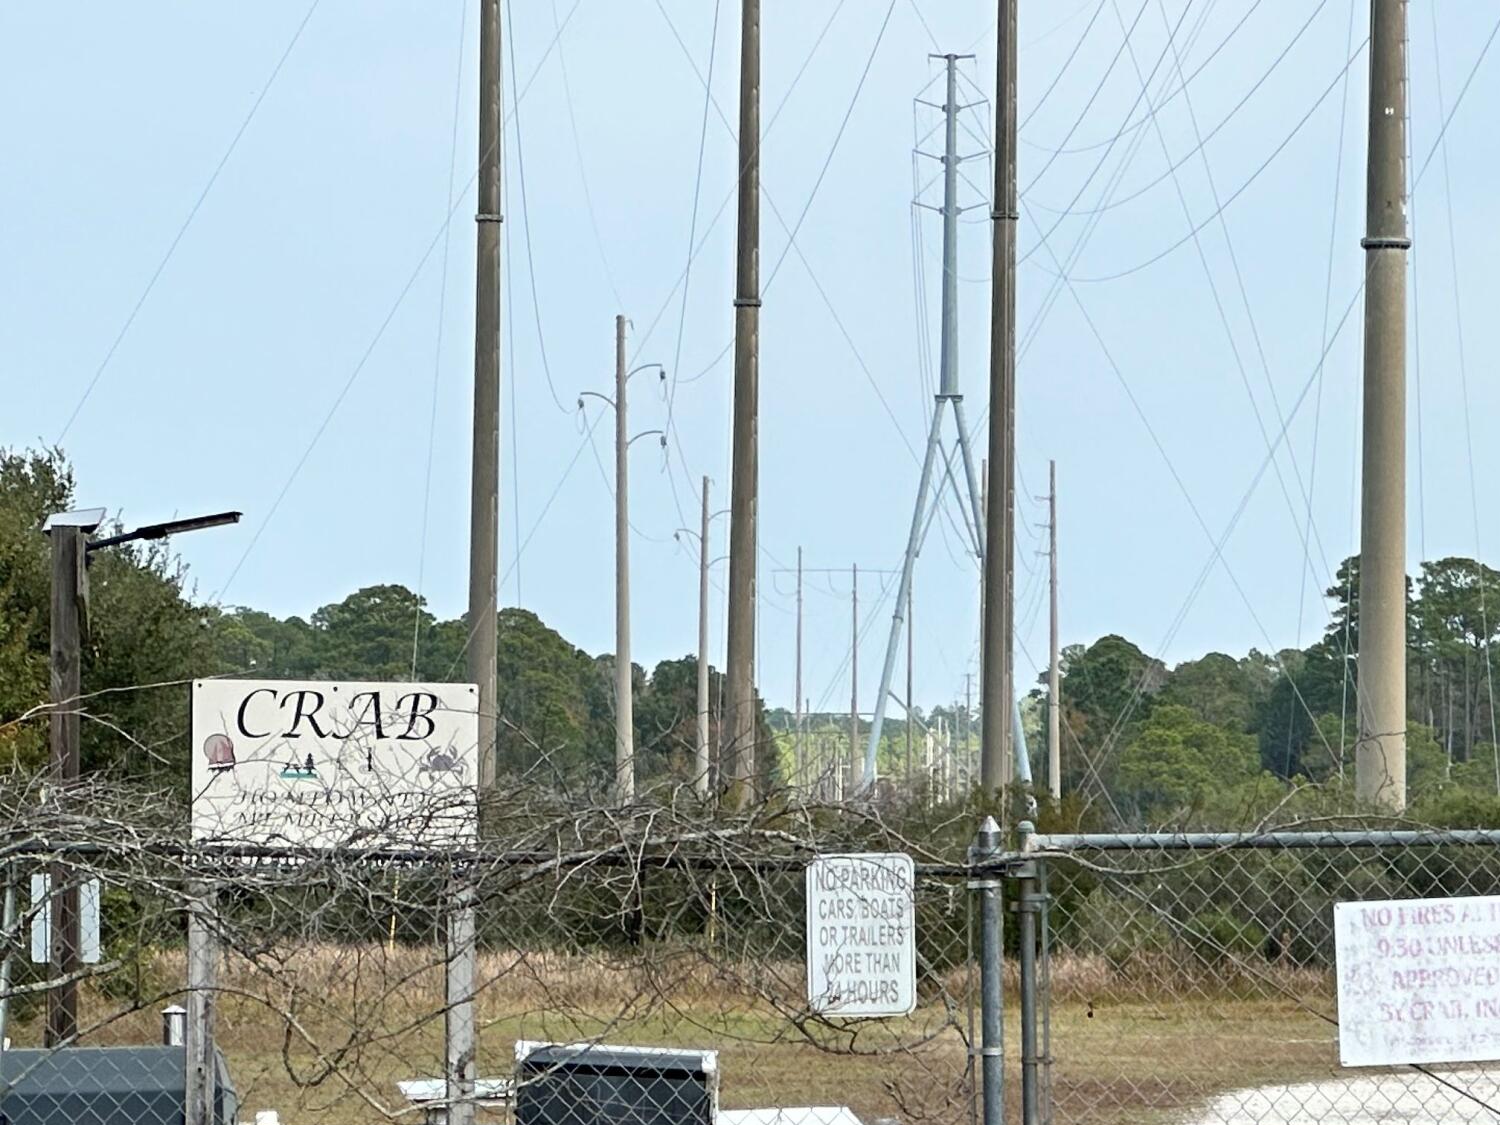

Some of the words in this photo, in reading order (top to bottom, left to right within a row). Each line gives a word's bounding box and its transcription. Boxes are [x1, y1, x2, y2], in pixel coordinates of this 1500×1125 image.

[236, 688, 439, 741] CRAB
[815, 867, 837, 891] NO
[841, 866, 907, 891] PARKING
[862, 898, 905, 919] BOATS
[1361, 907, 1393, 928] NO
[820, 926, 838, 947] OR
[843, 926, 905, 947] TRAILERS
[824, 953, 862, 974] MORE
[866, 953, 901, 973] THAN
[847, 980, 900, 1004] HOURS
